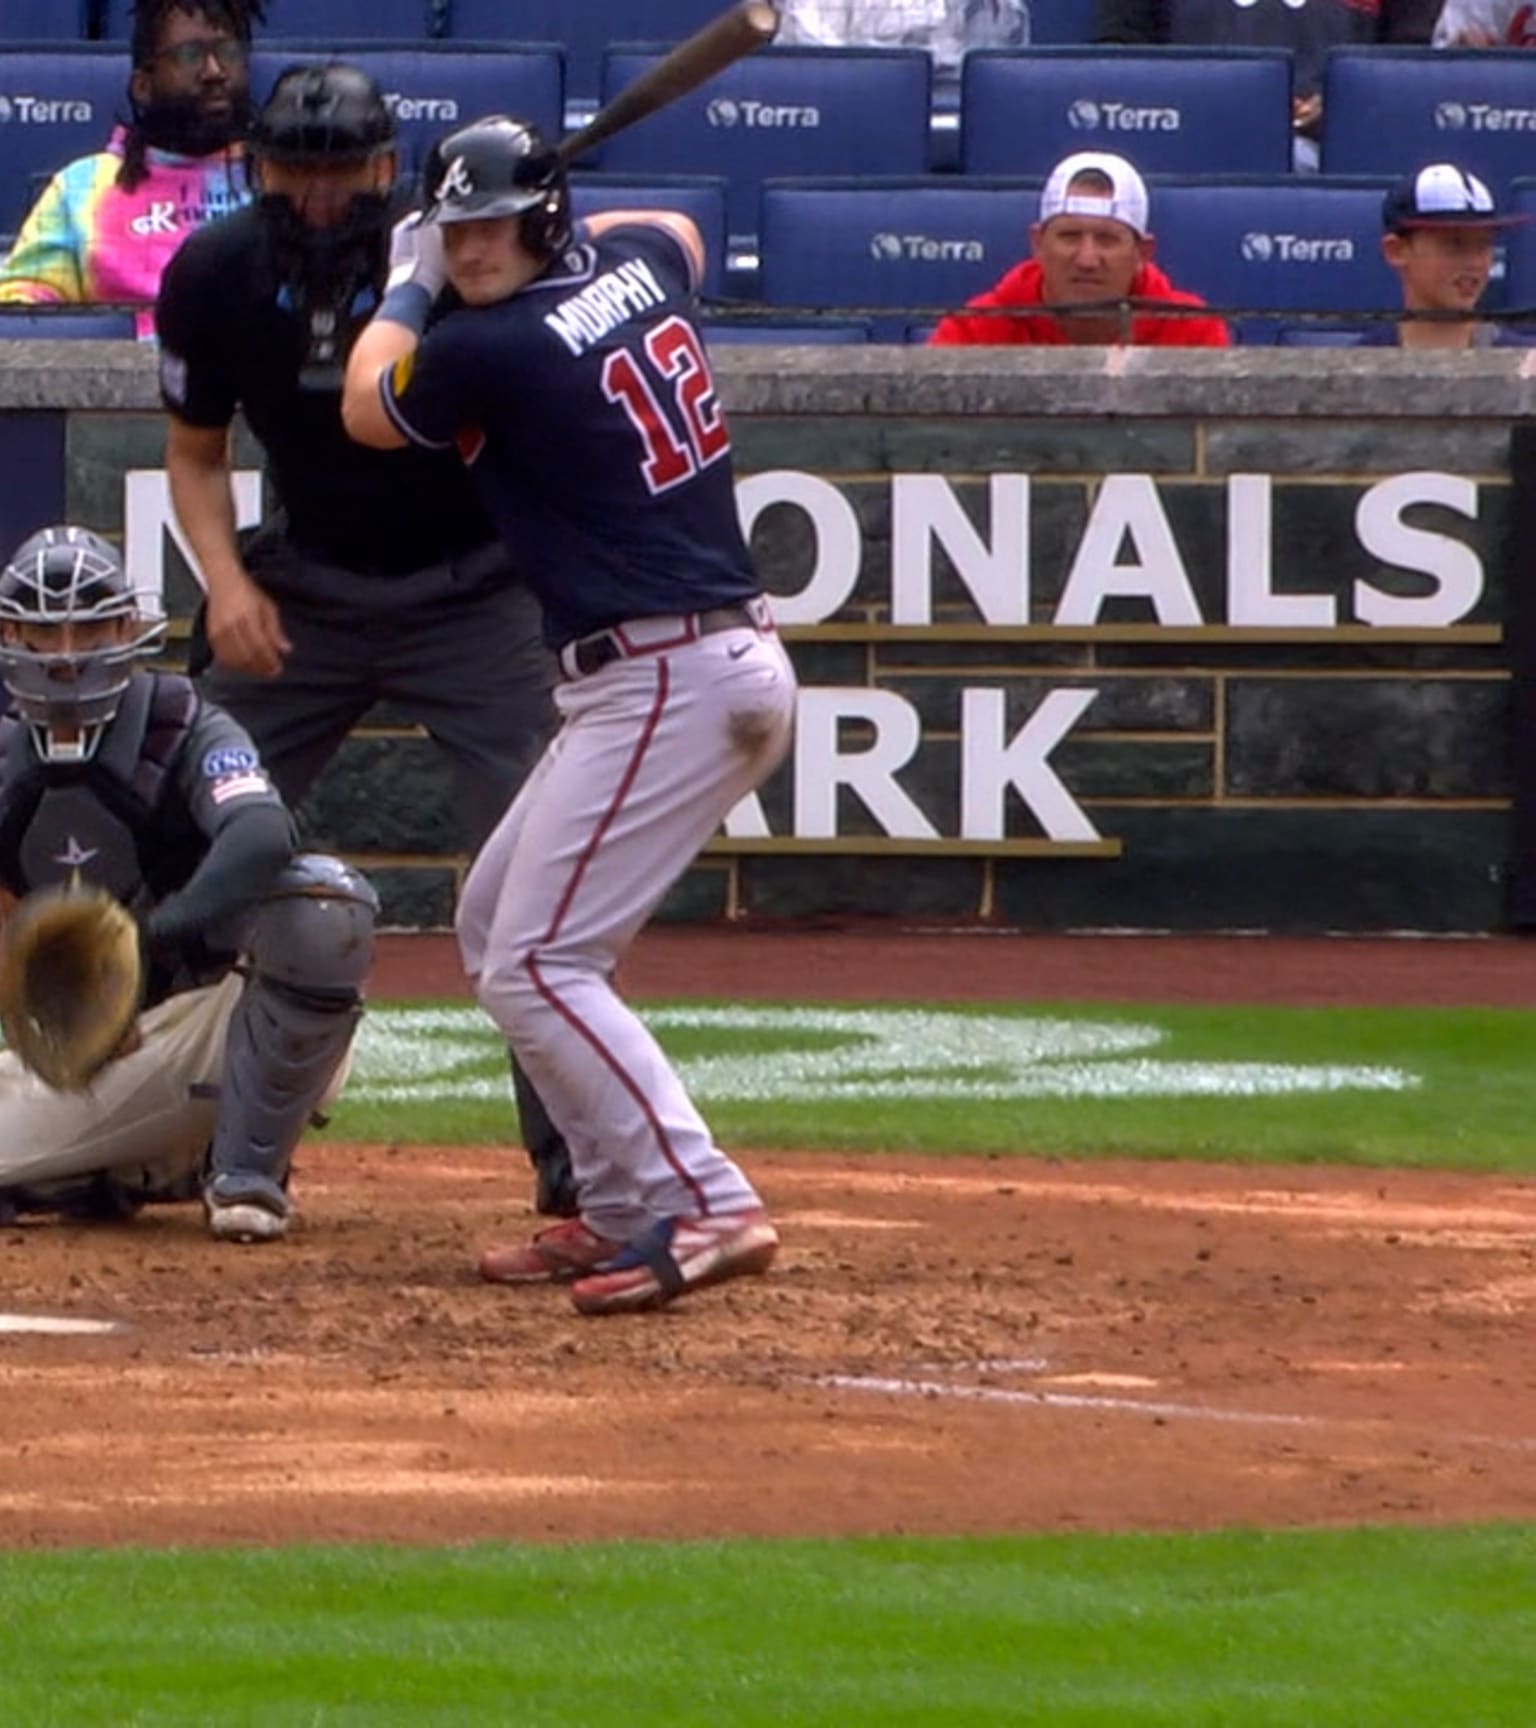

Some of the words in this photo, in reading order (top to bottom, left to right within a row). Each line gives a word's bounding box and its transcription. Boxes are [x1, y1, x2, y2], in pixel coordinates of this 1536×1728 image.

[14, 96, 93, 122] Terra
[381, 93, 459, 120] Terra
[739, 101, 820, 127] Terra
[1101, 102, 1181, 130] Terra
[903, 234, 984, 261] Terra
[1274, 234, 1354, 261] Terra
[543, 257, 667, 358] MURPHY
[600, 314, 732, 496] 12
[124, 469, 1484, 628] NONALS
[718, 686, 1102, 841] RK
